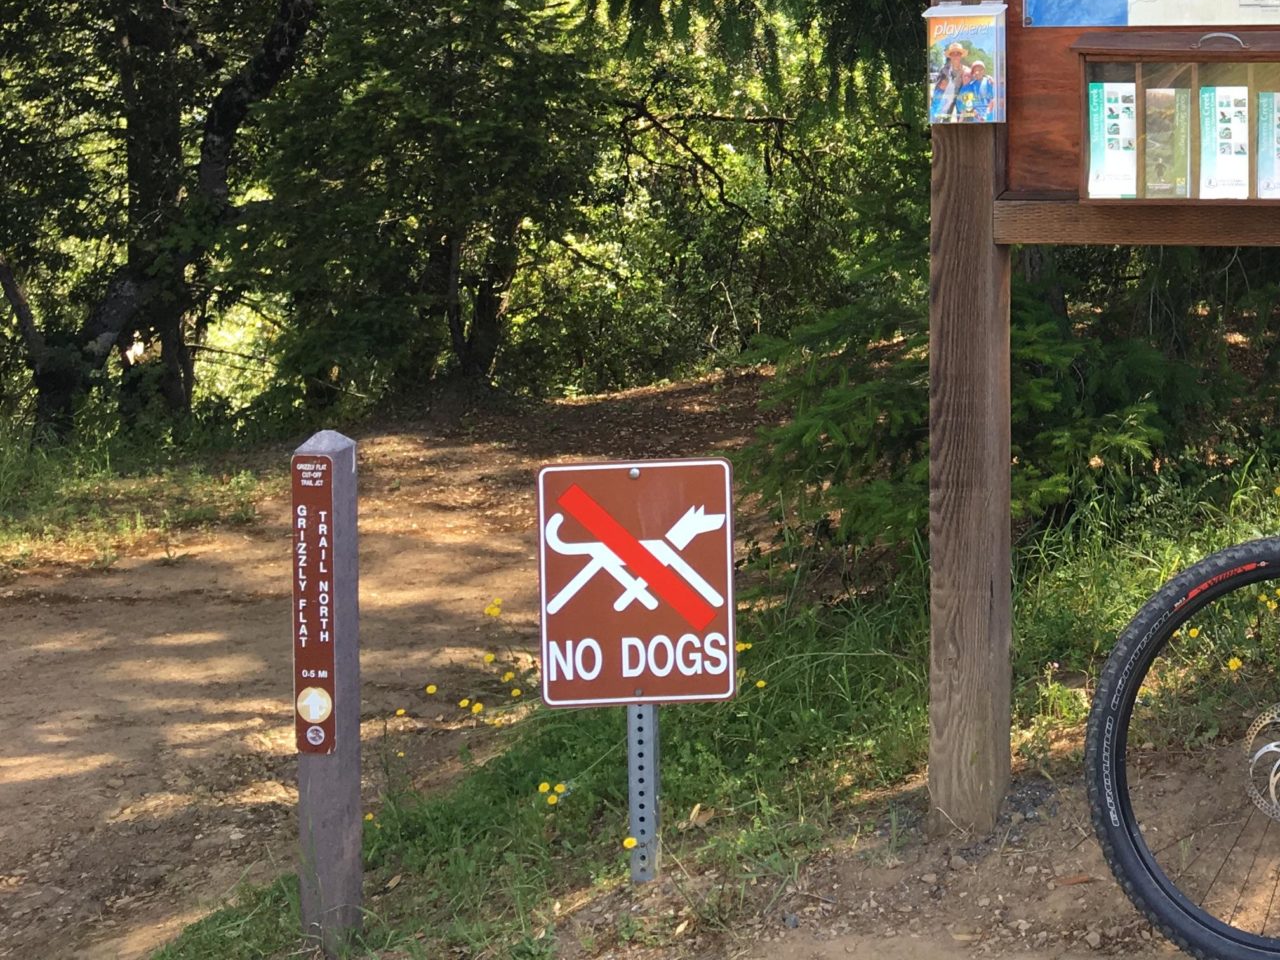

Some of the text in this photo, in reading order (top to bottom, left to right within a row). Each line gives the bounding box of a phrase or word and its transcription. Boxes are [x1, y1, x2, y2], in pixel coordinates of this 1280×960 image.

[301, 471, 323, 479] CUT-OFF
[315, 463, 327, 471] FLAT
[297, 504, 308, 649] GRIZZLY FLAT
[318, 511, 330, 643] TRAIL NORTH
[317, 669, 328, 678] MI
[548, 632, 728, 682] NO DOGS
[1111, 609, 1175, 711] CONTROL
[1103, 716, 1121, 828] GROUND
